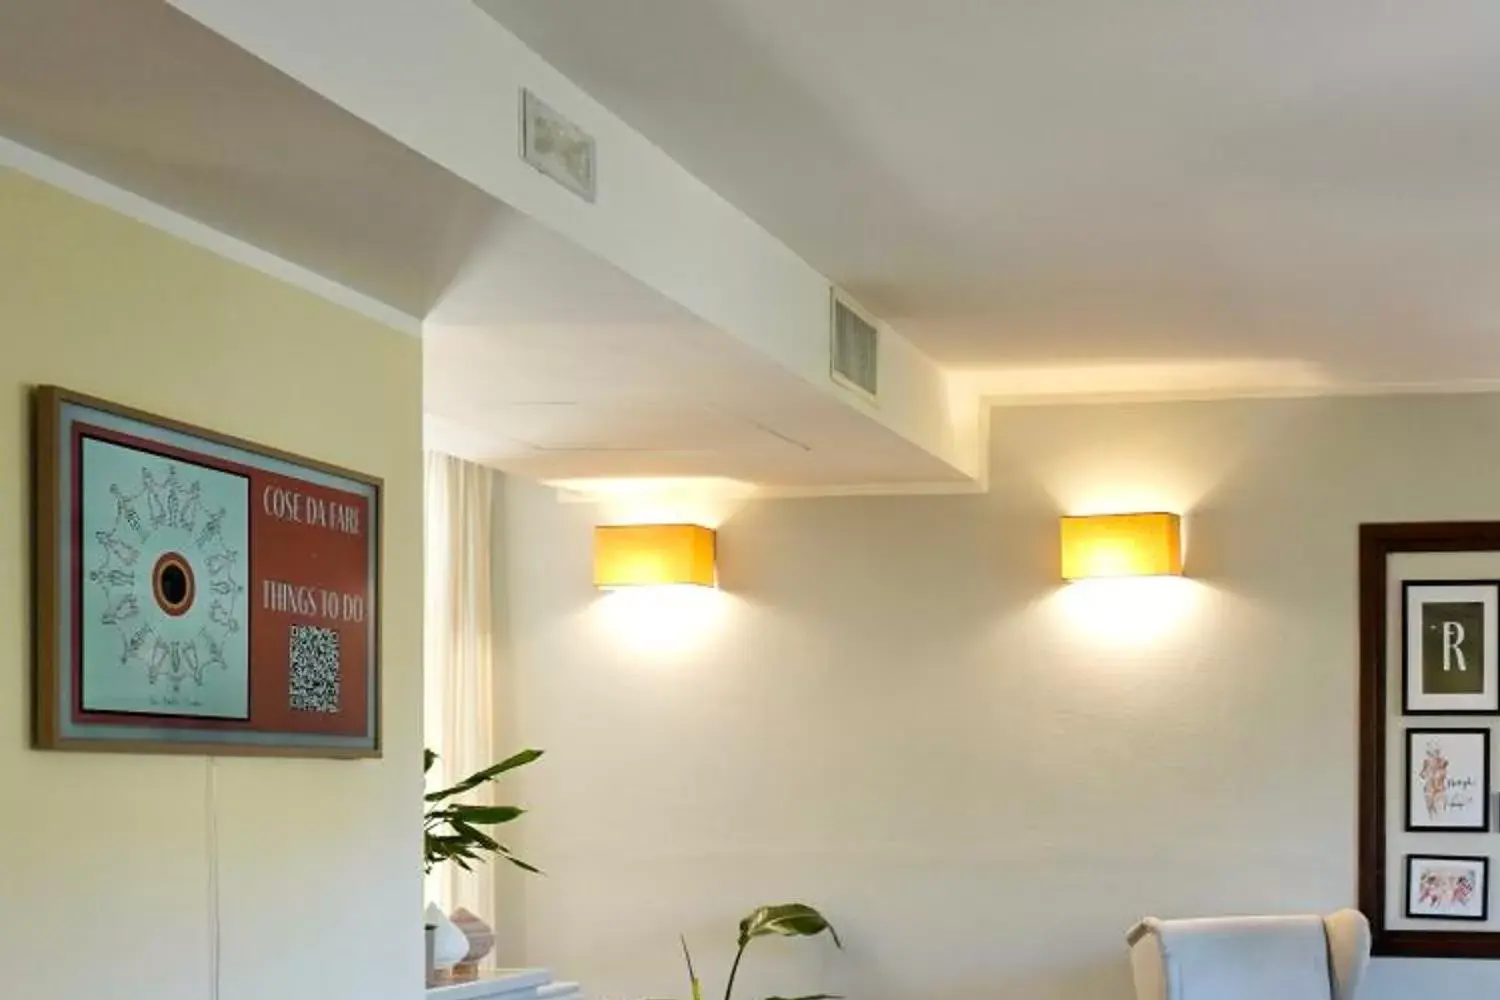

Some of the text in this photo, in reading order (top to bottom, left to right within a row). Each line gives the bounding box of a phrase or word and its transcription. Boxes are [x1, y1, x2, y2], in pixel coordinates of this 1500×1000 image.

[263, 484, 360, 534] COSE DA FARE
[263, 580, 364, 623] THINGS TO DO
[1443, 620, 1467, 671] R
